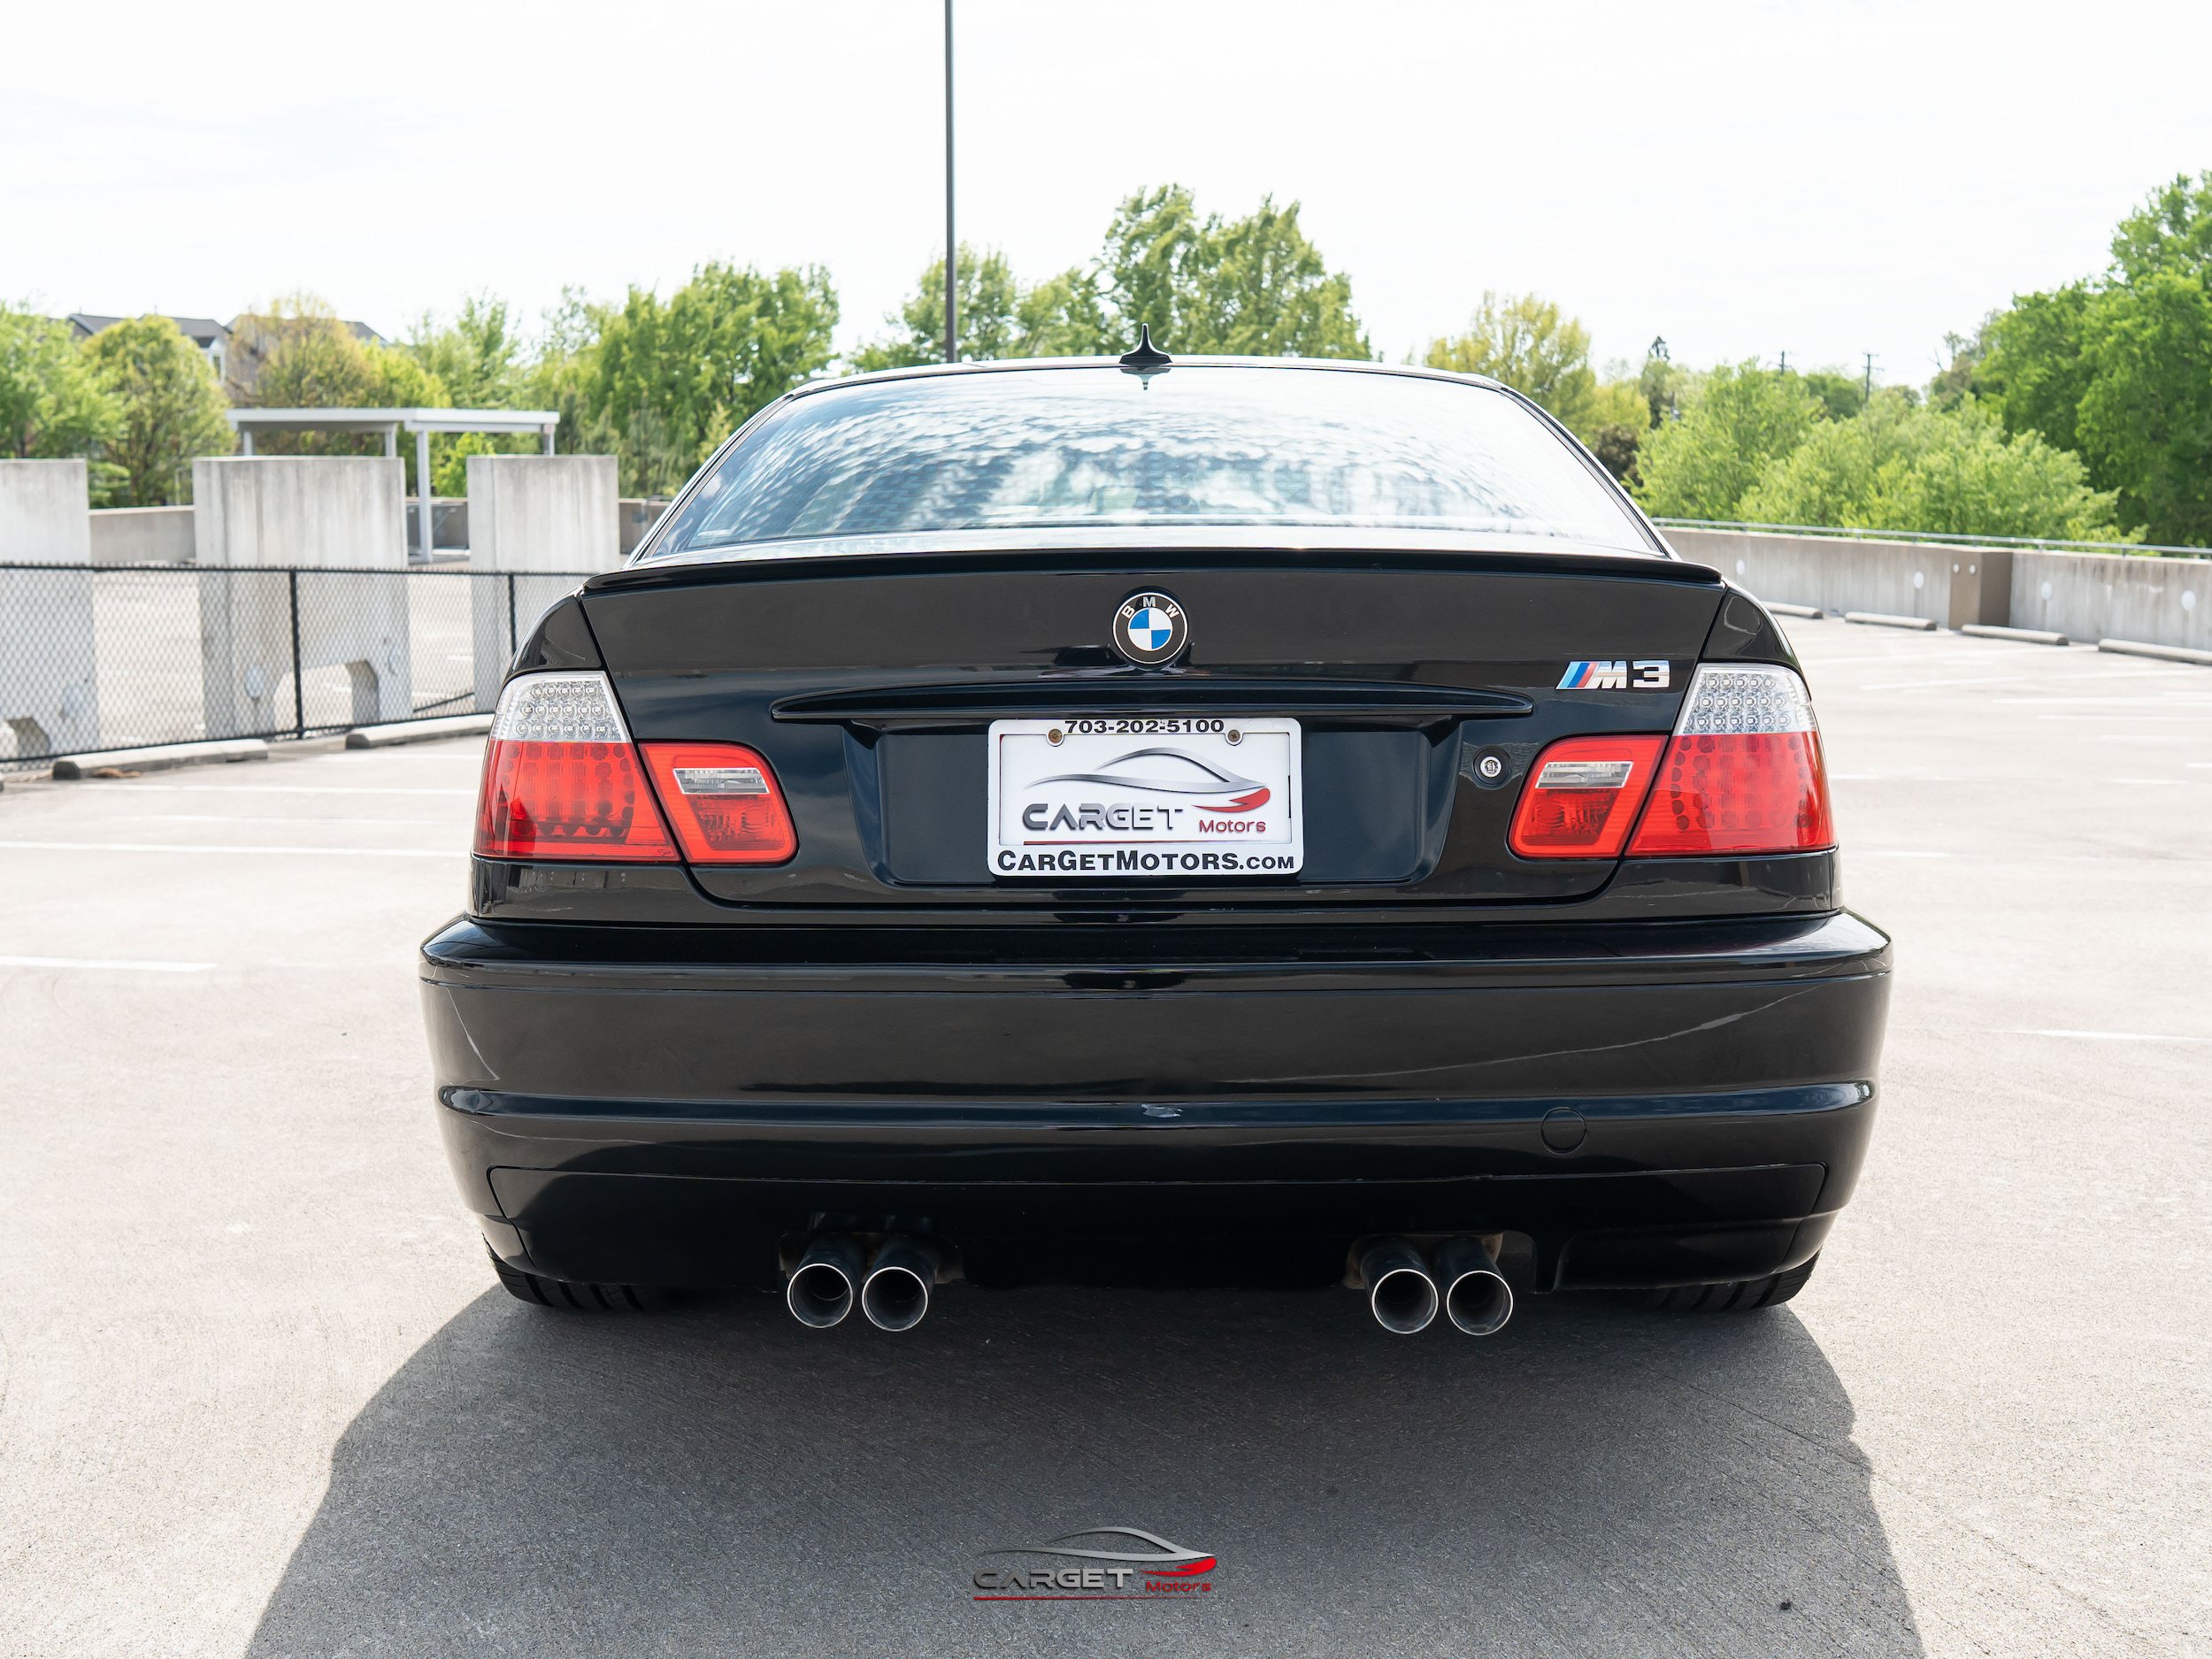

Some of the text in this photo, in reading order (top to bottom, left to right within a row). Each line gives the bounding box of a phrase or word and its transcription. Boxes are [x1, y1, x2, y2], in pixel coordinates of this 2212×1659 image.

[1121, 596, 1179, 618] BMW
[1584, 660, 1670, 689] M3
[1064, 719, 1225, 733] 703-202-5100
[1023, 803, 1183, 830] CARGET
[1199, 819, 1266, 833] Motors
